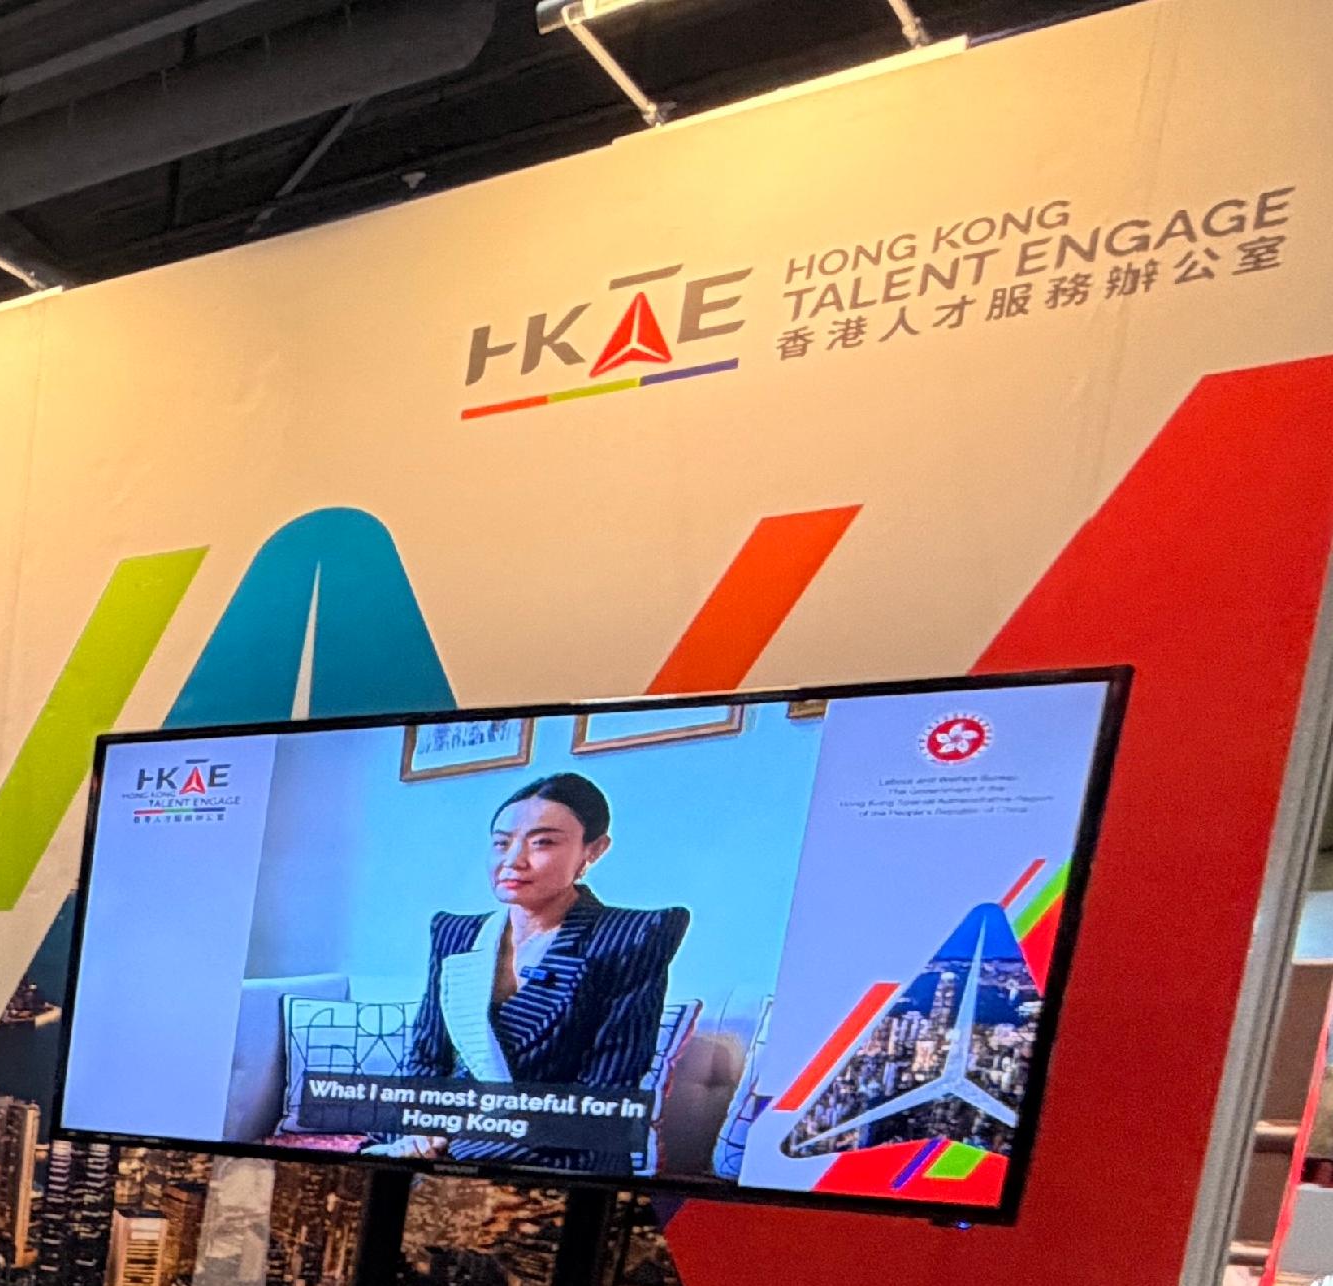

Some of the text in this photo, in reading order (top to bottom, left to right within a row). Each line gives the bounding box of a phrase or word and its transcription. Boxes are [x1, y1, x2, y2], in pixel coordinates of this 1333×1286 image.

[783, 186, 1297, 323] TALENT ENGAGE
[784, 200, 1072, 285] HONG KONG
[775, 234, 1288, 362] 香港人才服務辦公室
[309, 1080, 646, 1119] What I am most grateful for in
[402, 1109, 529, 1138] Hong Kong
